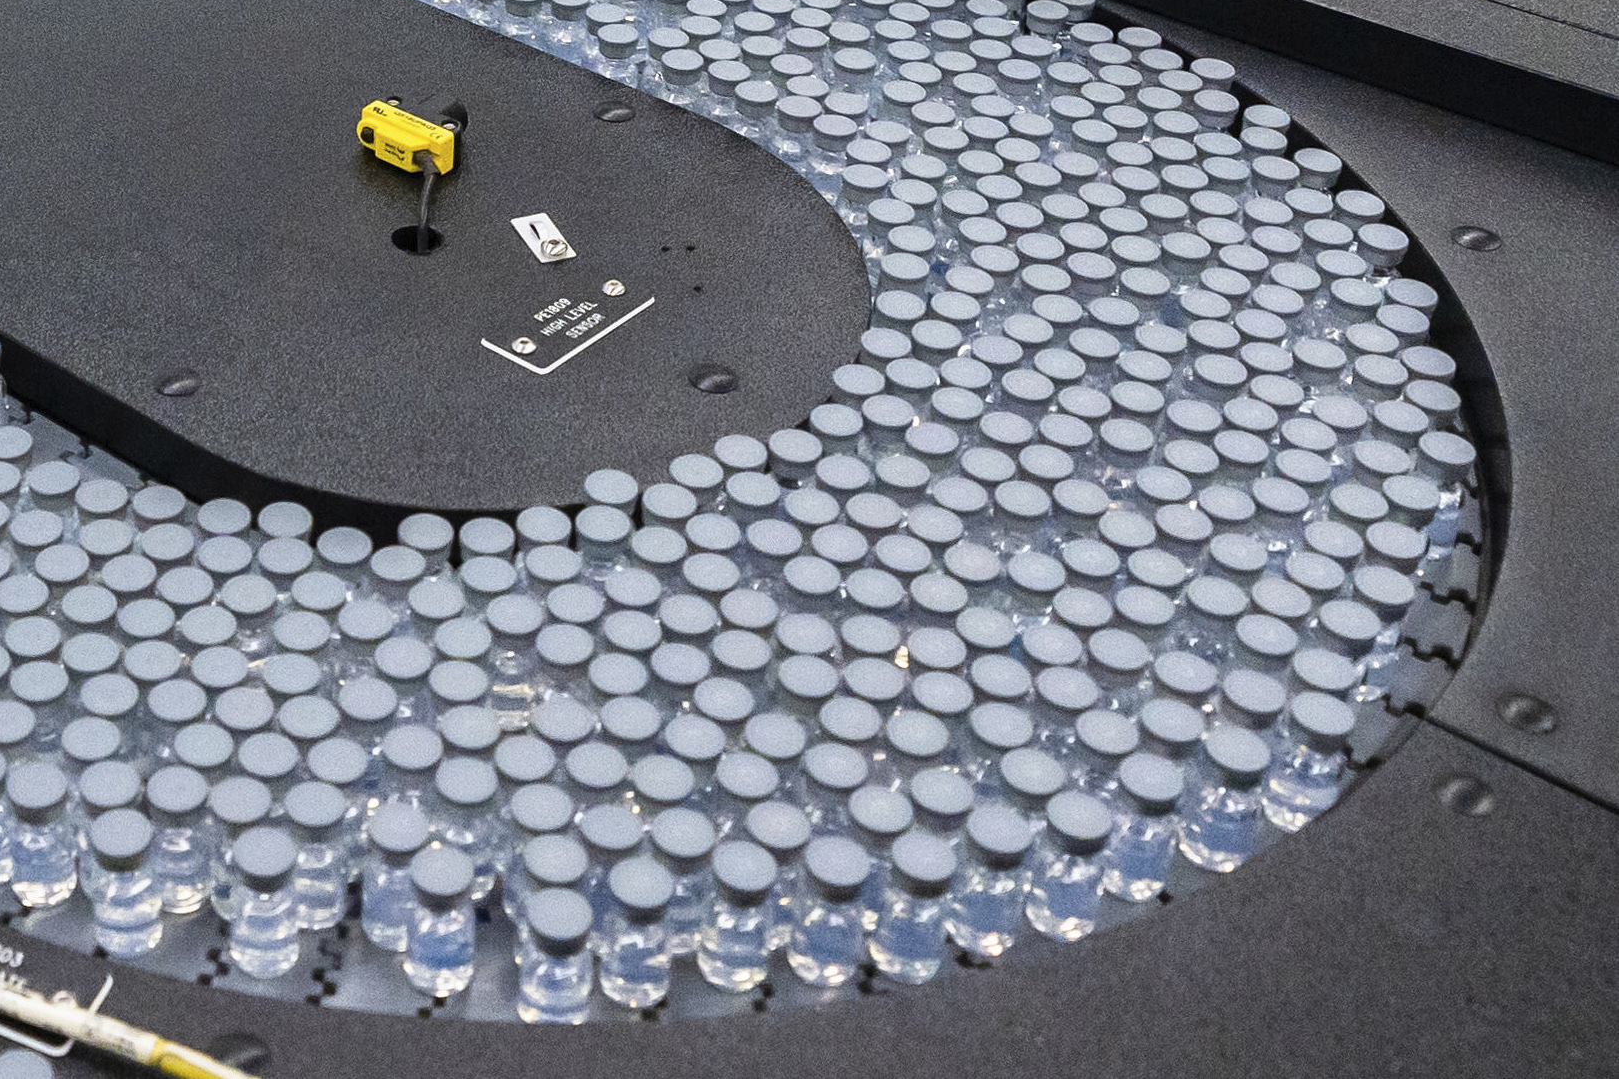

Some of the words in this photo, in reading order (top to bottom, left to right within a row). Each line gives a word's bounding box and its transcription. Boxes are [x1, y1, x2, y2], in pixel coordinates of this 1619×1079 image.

[533, 298, 571, 322] PE1809
[540, 318, 568, 337] HIGH
[564, 301, 598, 321] LEVEL
[565, 313, 606, 339] SENSOR
